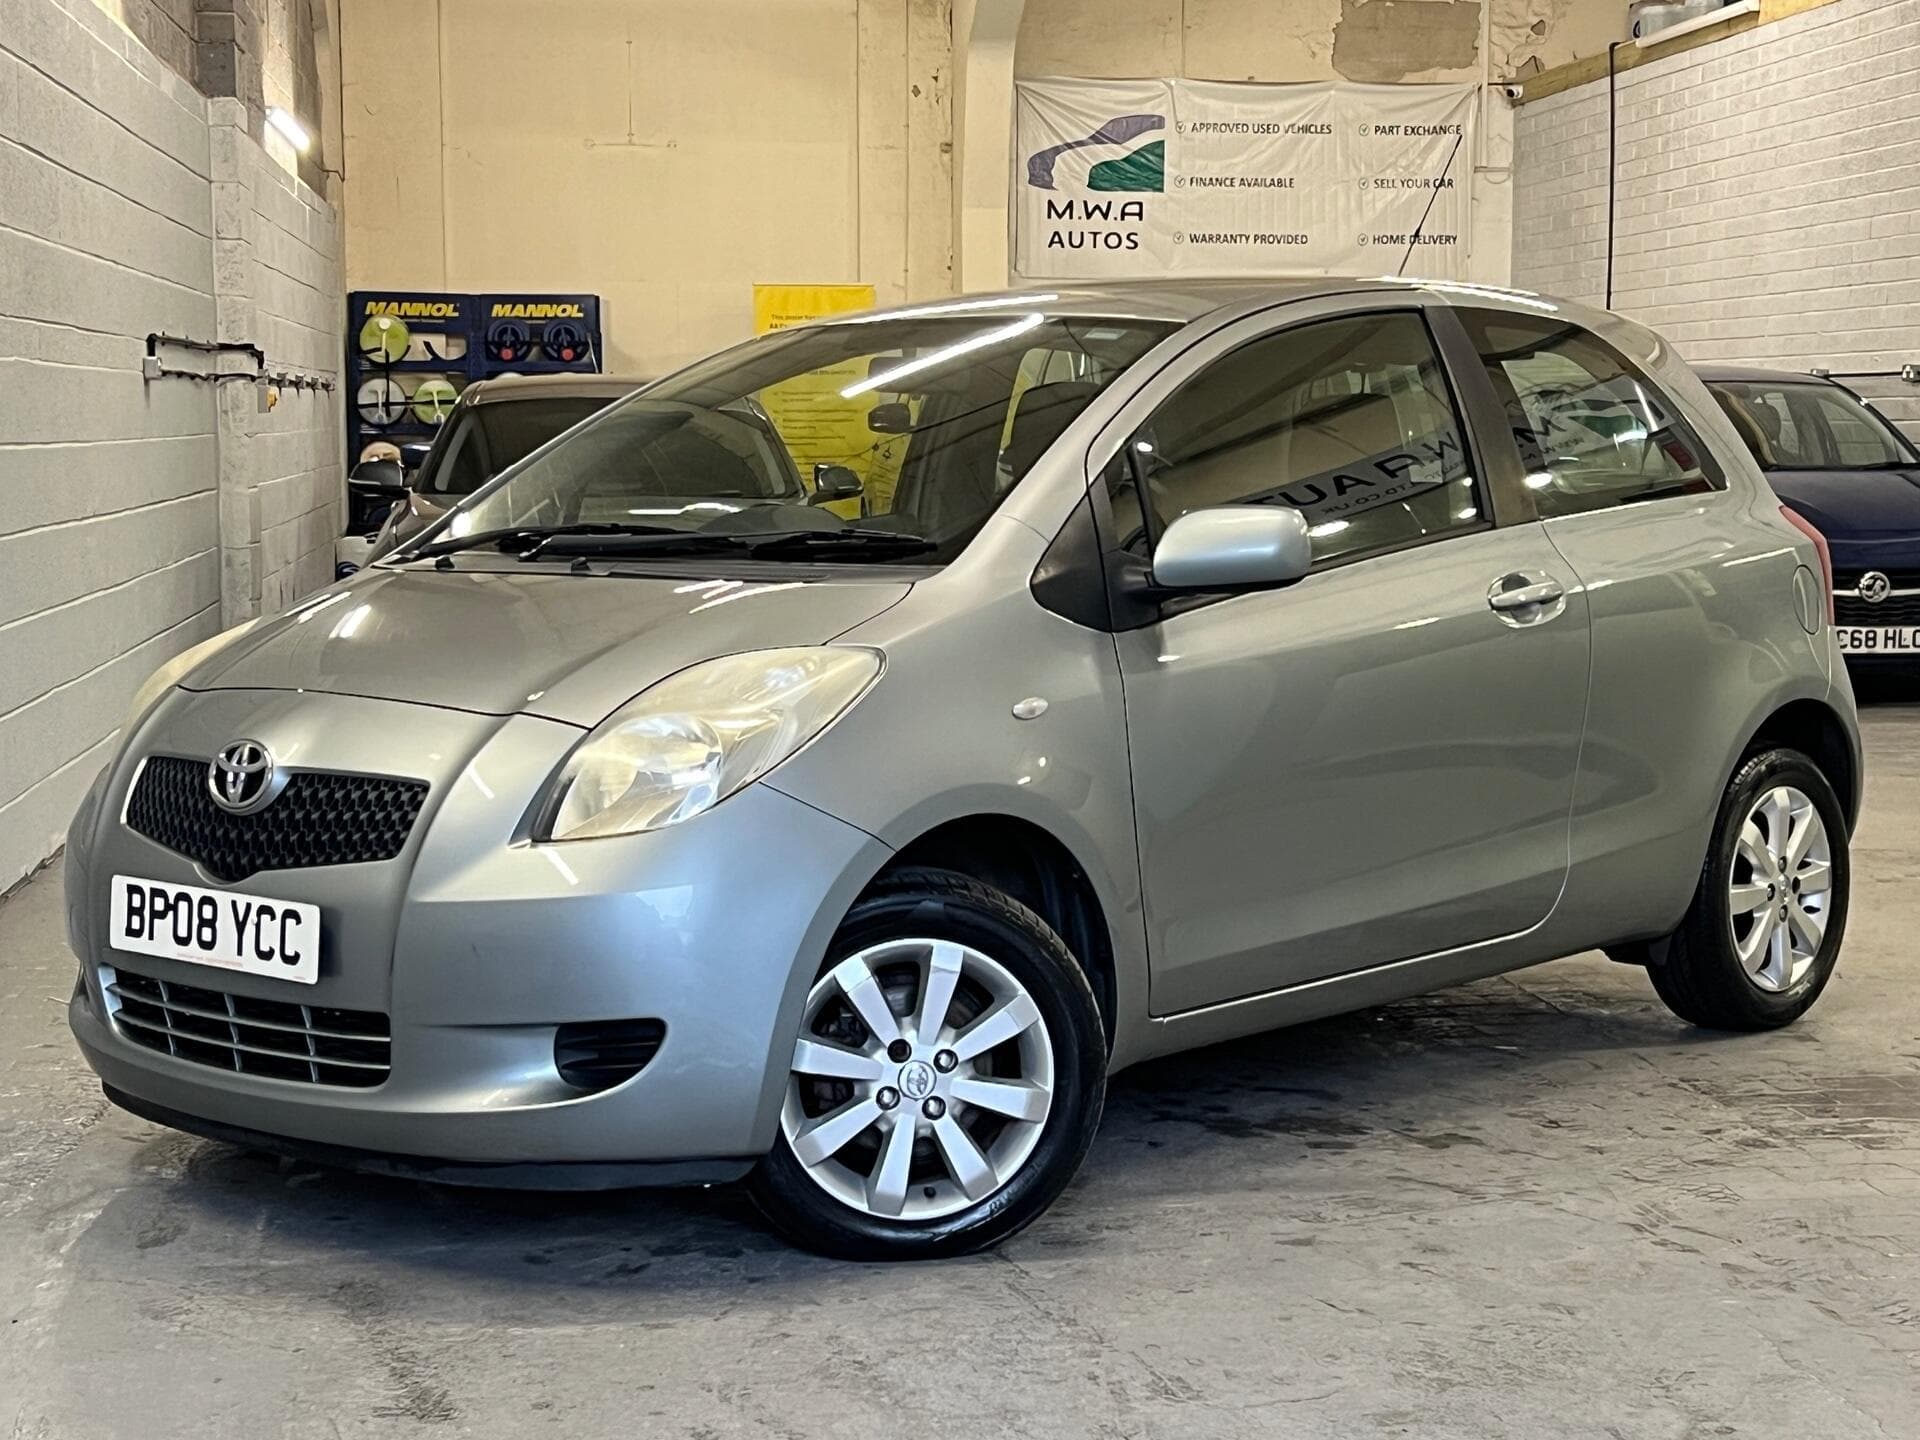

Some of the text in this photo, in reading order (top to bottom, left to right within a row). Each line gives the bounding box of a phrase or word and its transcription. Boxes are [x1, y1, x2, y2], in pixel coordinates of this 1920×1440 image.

[1191, 122, 1332, 135] APPROVED USED VEHICLES
[1374, 124, 1462, 136] PART EXCHANGE
[1189, 176, 1295, 188] FINANCE AVAILABLE
[1374, 178, 1454, 189] SELL YOUR CAR
[1046, 199, 1144, 222] M.W.A
[1047, 230, 1140, 251] AUTOS
[1189, 233, 1308, 245] WARRANTY PROVIDED
[1372, 234, 1458, 245] HOME DELIVERY
[364, 301, 459, 317] MANNOL
[491, 303, 584, 318] MANNOL
[125, 883, 302, 966] BP08 YCC
